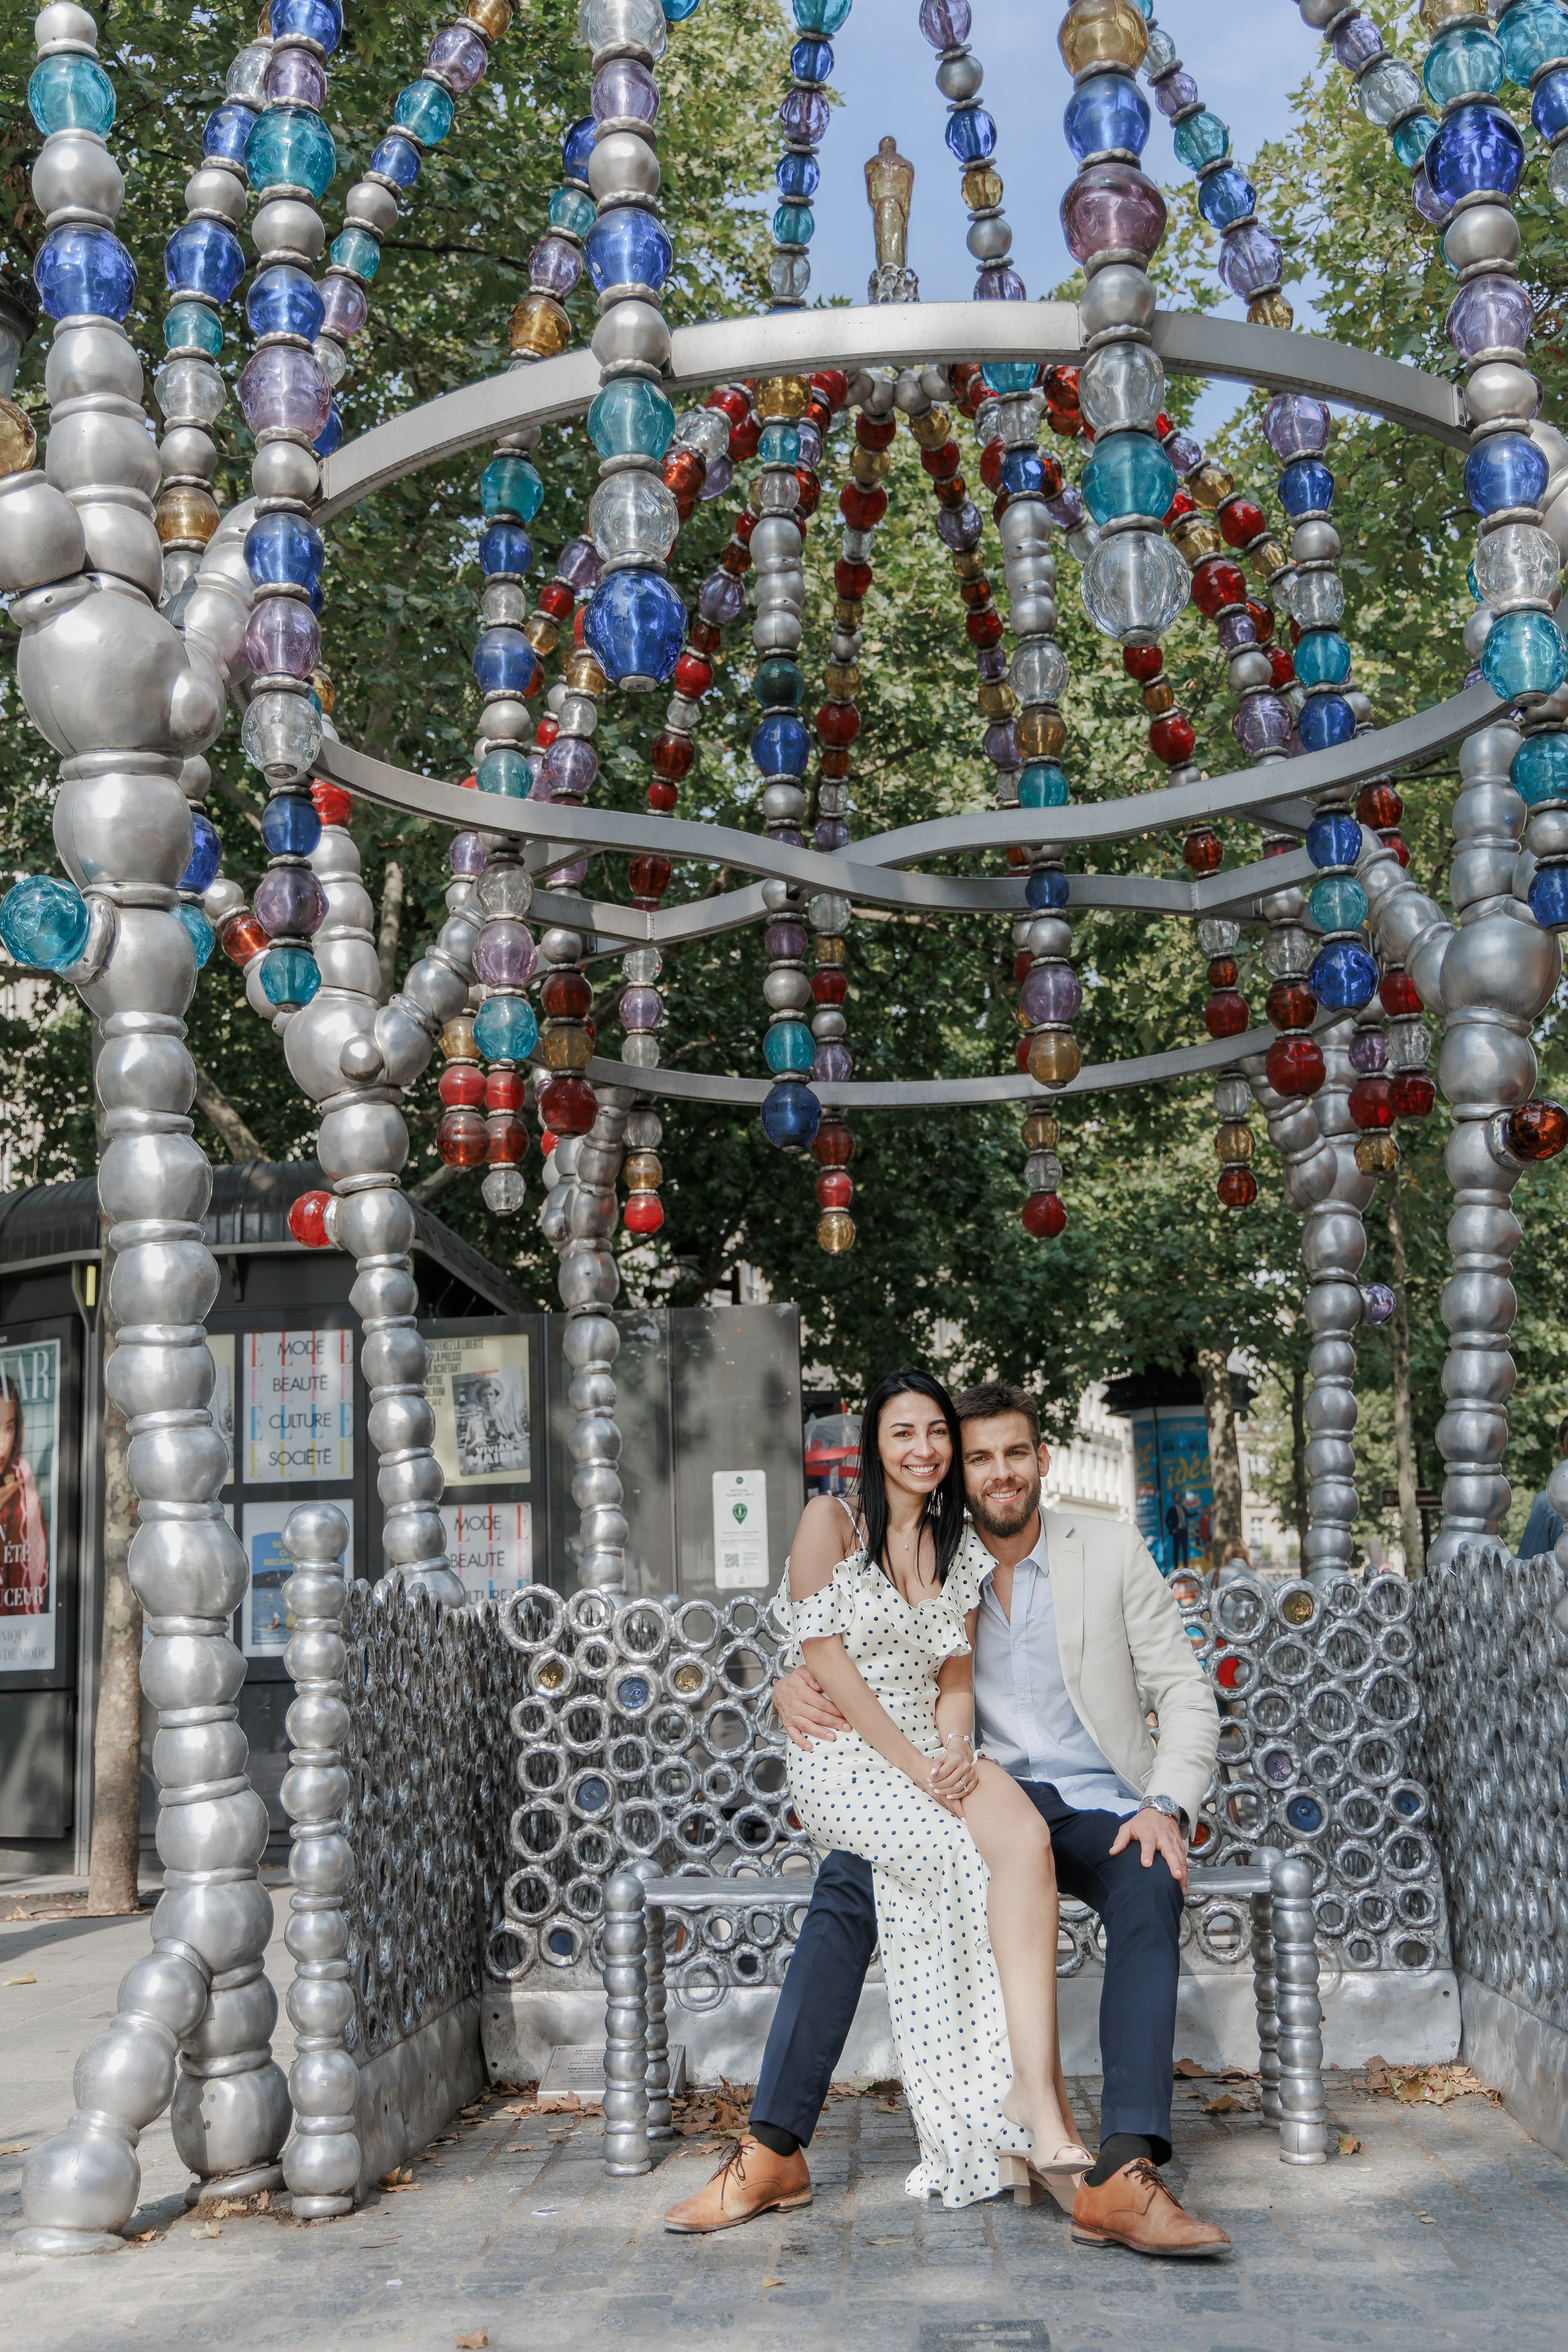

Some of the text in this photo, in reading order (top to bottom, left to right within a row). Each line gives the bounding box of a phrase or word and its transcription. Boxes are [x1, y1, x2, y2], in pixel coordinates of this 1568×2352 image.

[277, 1340, 324, 1355] MODE
[441, 1351, 462, 1362] PRESSE
[0, 1350, 50, 1403] AAR
[434, 1362, 461, 1374] ACHETANT
[273, 1374, 328, 1392] BEAUTÉ
[268, 1412, 331, 1429] CULTURE
[268, 1447, 332, 1466] SOCIÉTÉ
[467, 1449, 524, 1467] MAIER
[475, 1443, 514, 1455] VIVIAN
[454, 1515, 501, 1531] MODE
[4, 1539, 32, 1564] ÉTÉ
[450, 1550, 505, 1568] BEAUTÉ
[0, 1627, 32, 1645] NIQUE
